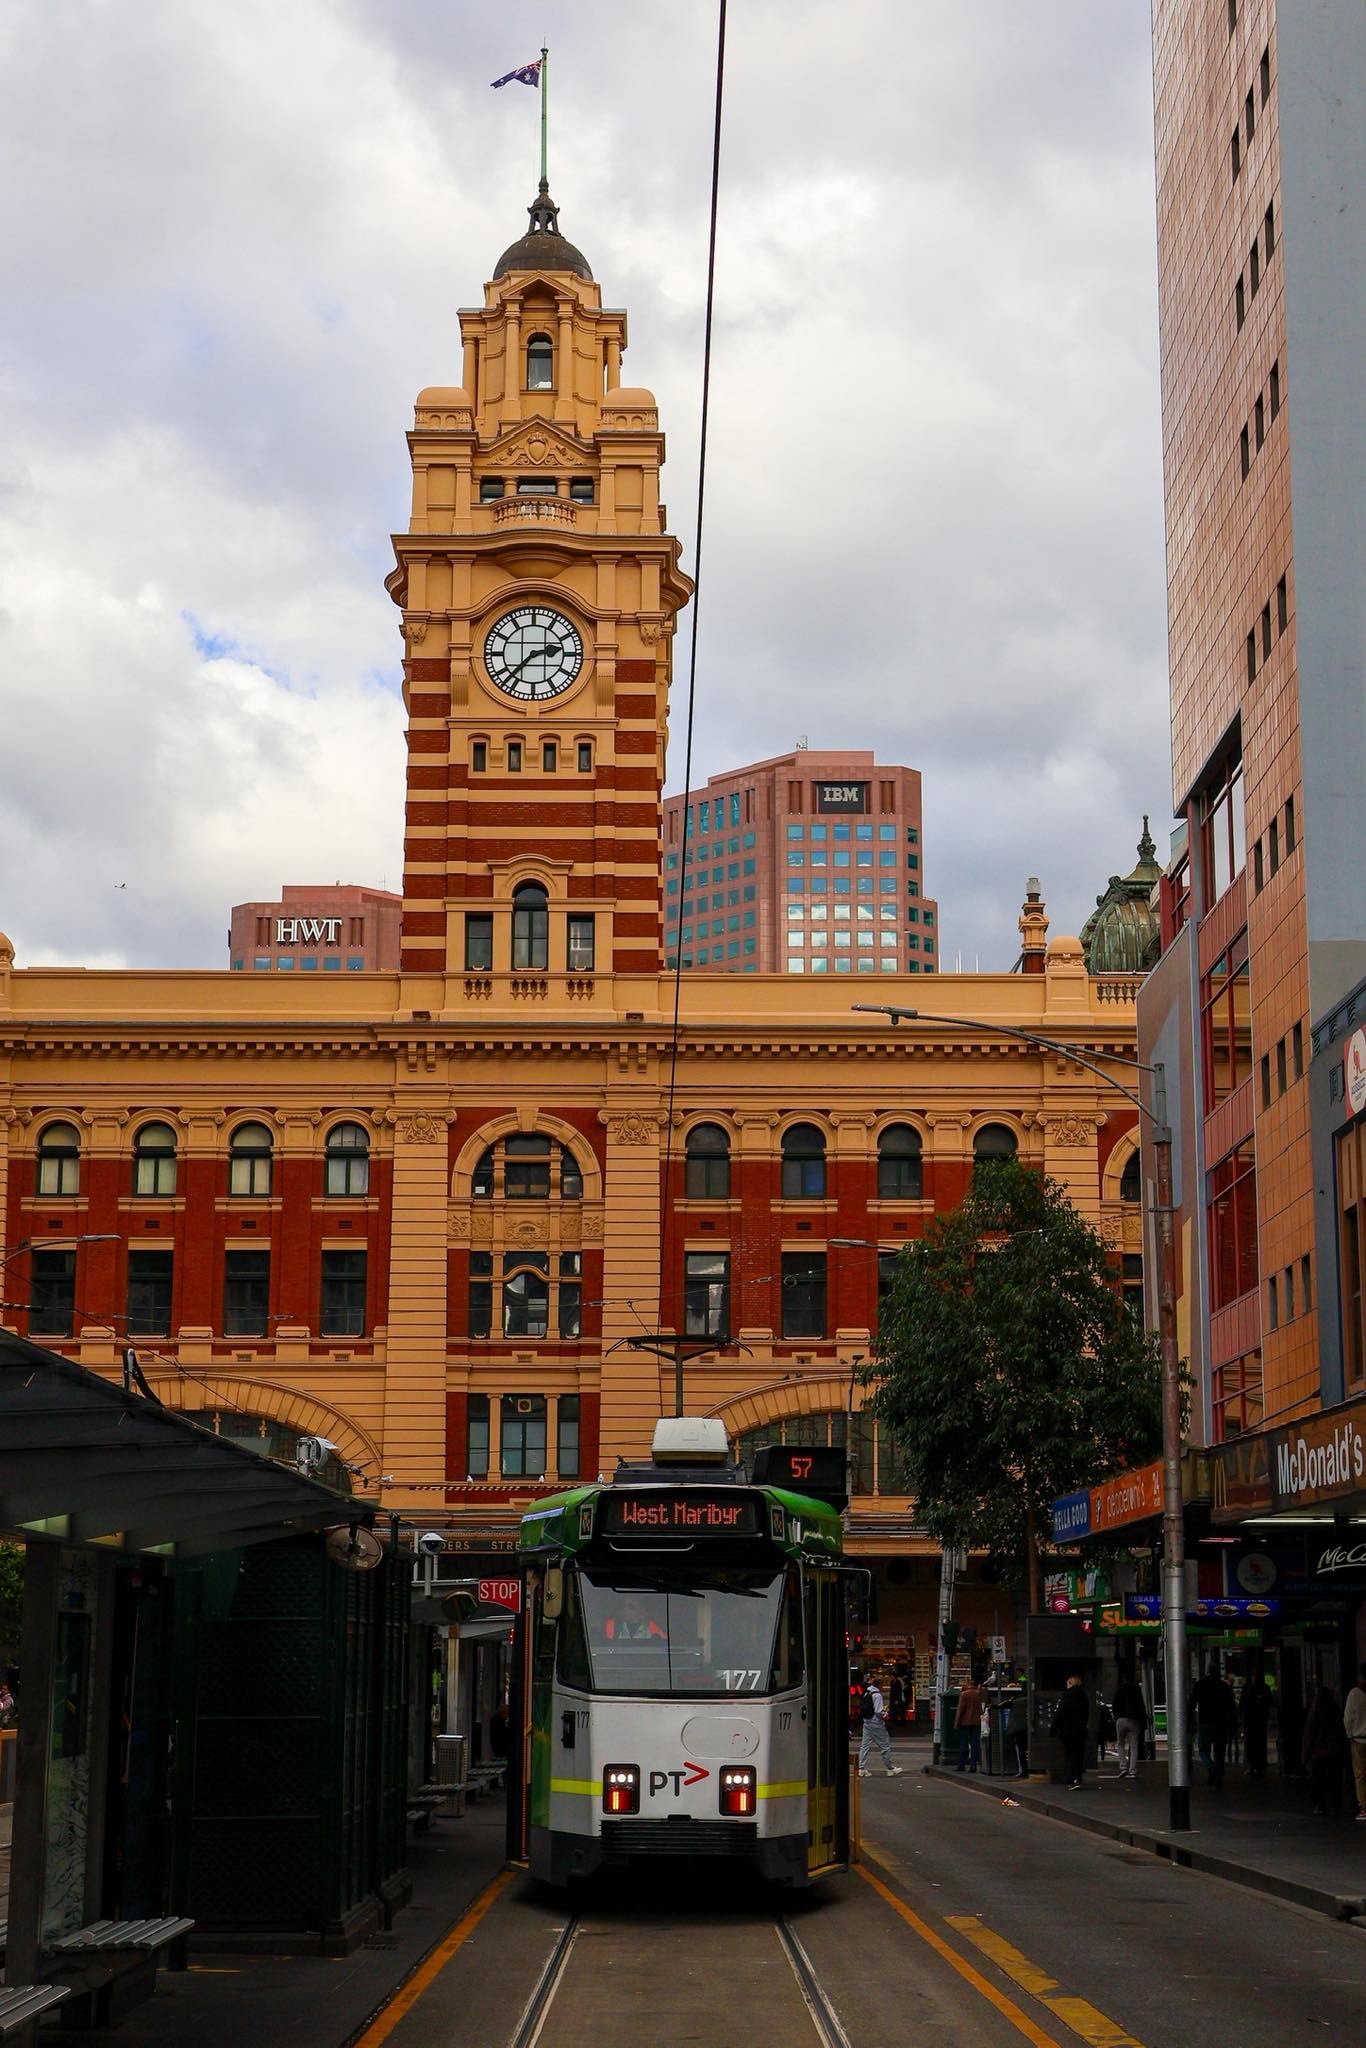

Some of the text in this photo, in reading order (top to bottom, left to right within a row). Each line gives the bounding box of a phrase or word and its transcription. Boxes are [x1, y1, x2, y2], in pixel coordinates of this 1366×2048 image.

[823, 787, 859, 801] IBM
[276, 918, 343, 942] HWT
[791, 1456, 813, 1479] 57
[1277, 1422, 1363, 1495] McDonald's
[622, 1501, 743, 1526] West Maribyr
[1072, 1502, 1087, 1526] GOOD
[409, 1541, 470, 1551] FDERS
[480, 1582, 519, 1600] STOP
[721, 1670, 761, 1690] 177
[576, 1711, 590, 1729] 177
[779, 1713, 792, 1730] 177
[650, 1771, 687, 1797] PT
